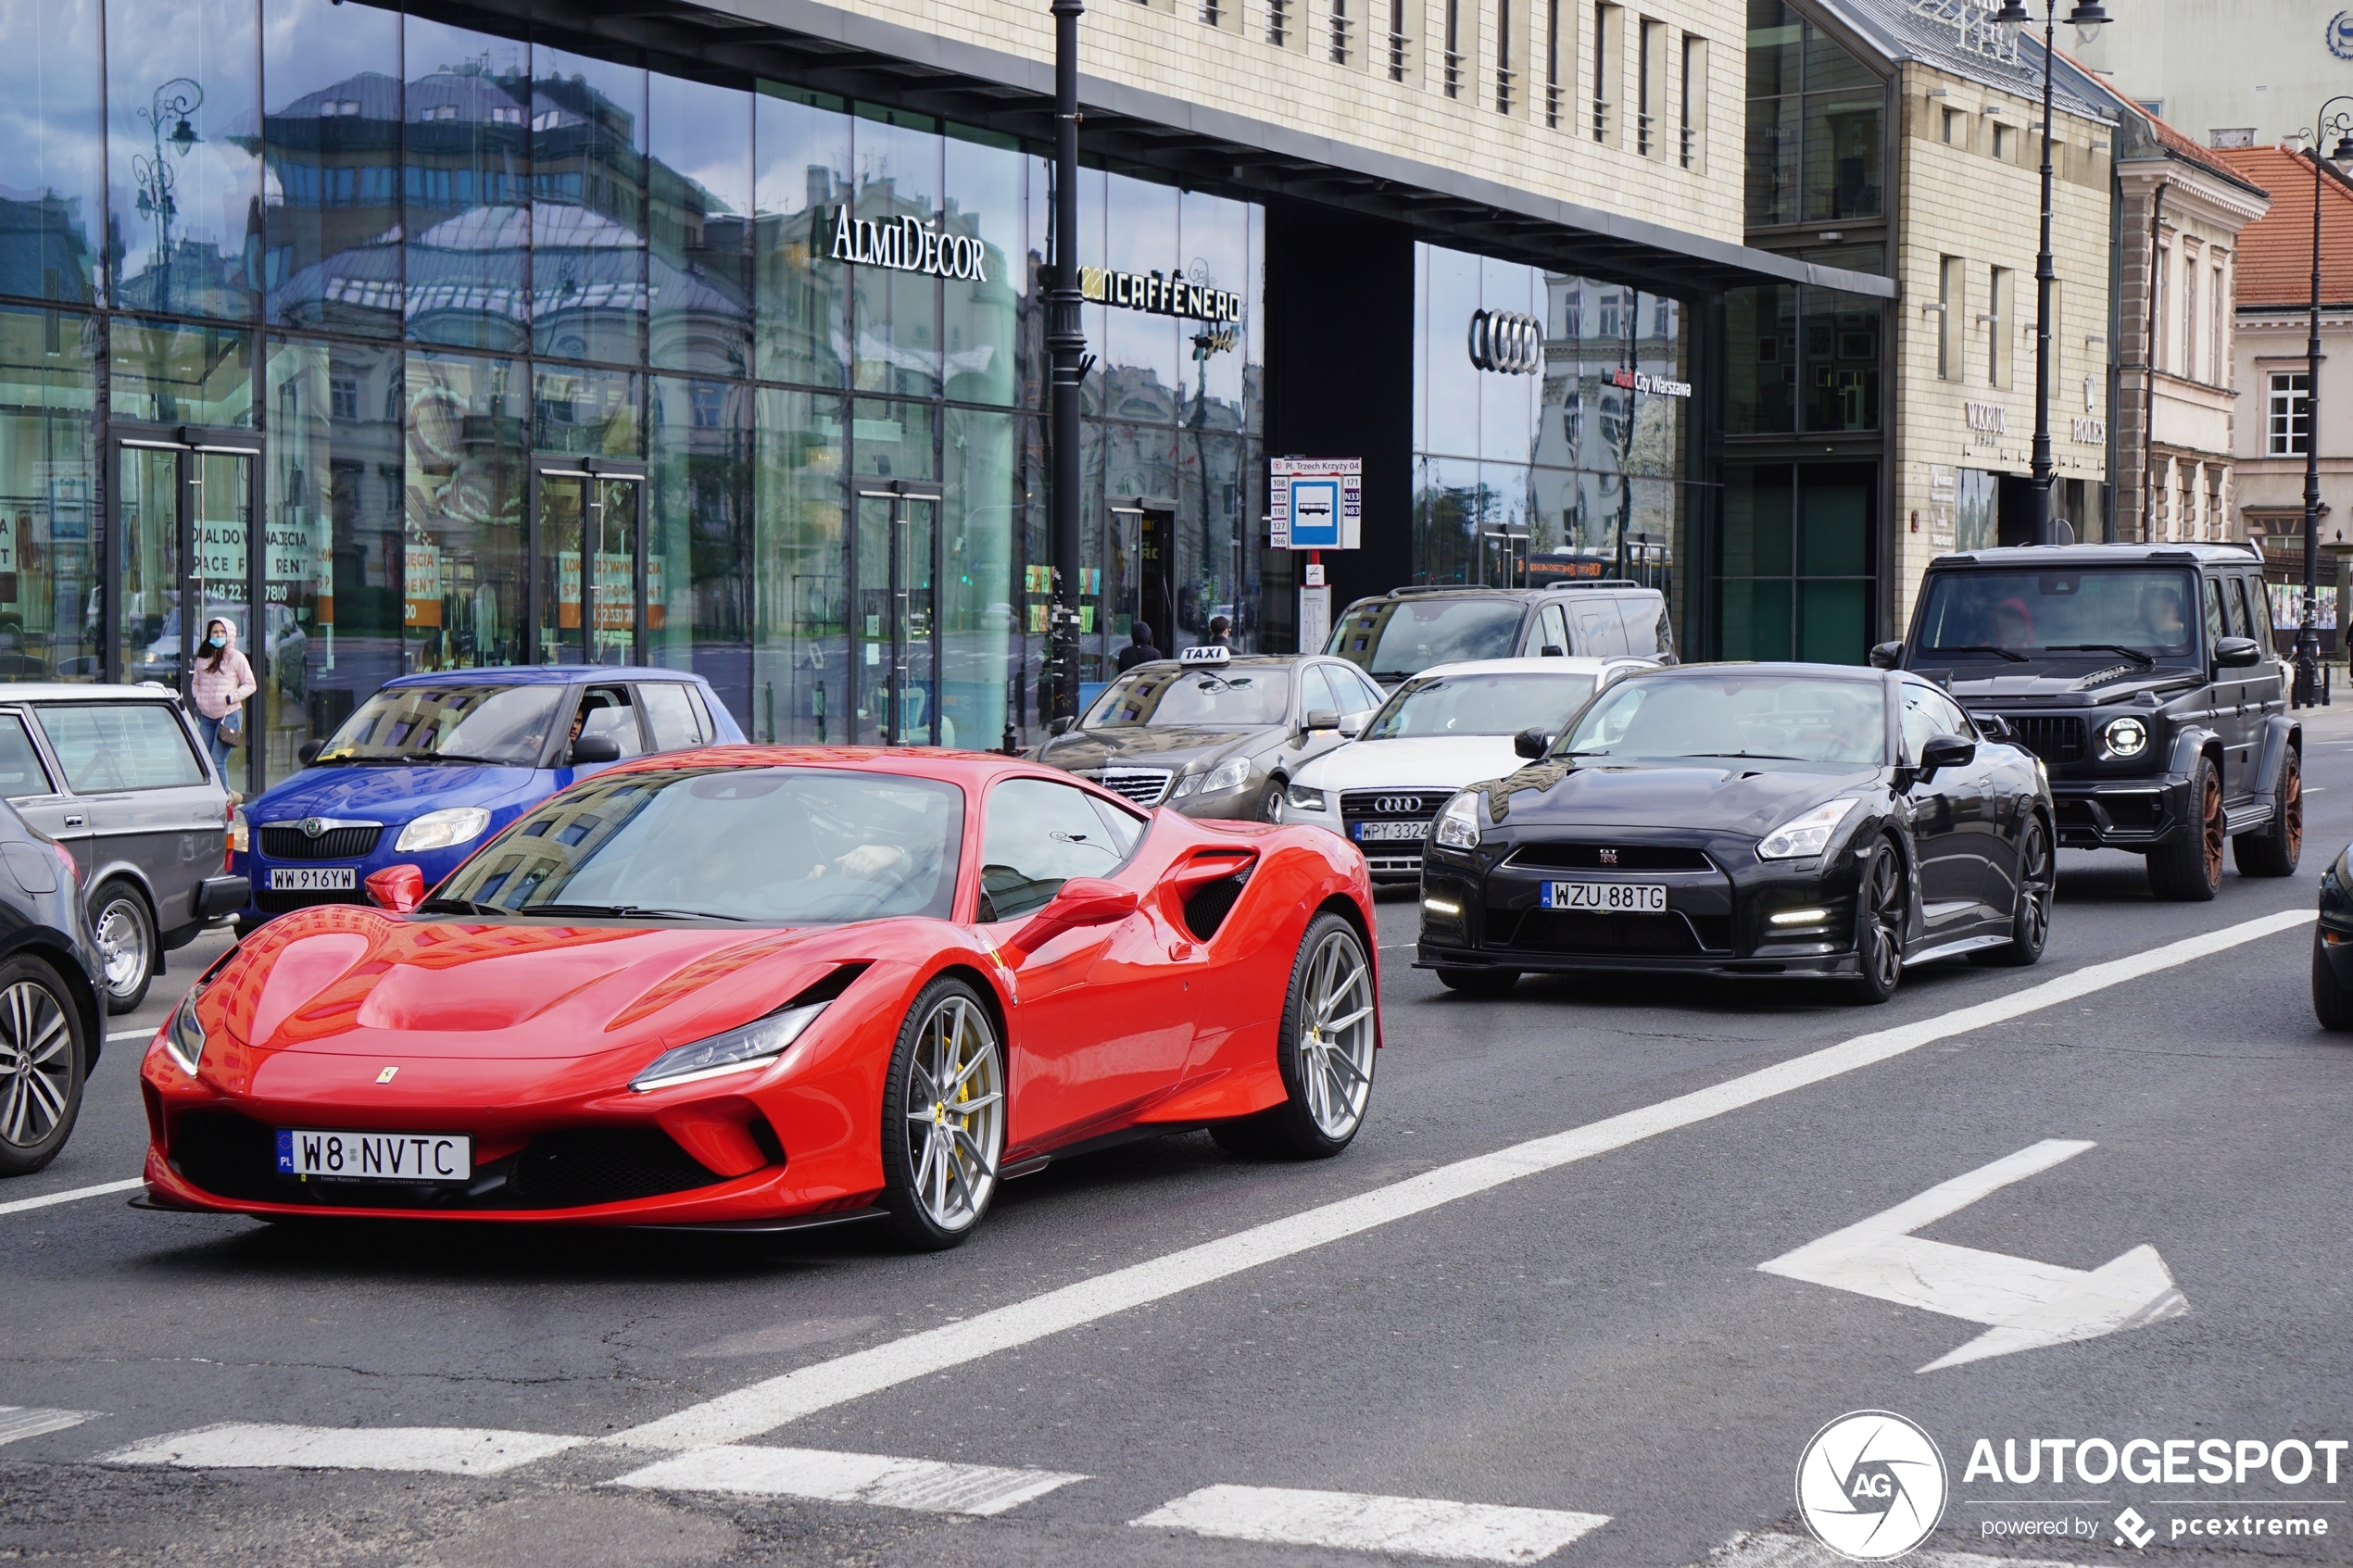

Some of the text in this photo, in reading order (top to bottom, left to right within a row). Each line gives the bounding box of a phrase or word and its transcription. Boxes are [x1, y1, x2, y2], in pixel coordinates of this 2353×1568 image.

[1189, 285, 1240, 322] NERO
[1612, 366, 1692, 397] Audi City Warszawa
[2072, 418, 2107, 445] ROLEX
[1322, 462, 1348, 471] Krzyży
[222, 529, 240, 545] DO
[193, 556, 229, 571] PACE
[276, 558, 308, 573] RENT
[205, 583, 225, 600] +48
[228, 584, 242, 600] 22
[606, 584, 627, 598] FOR
[1185, 647, 1223, 659] TAXI
[1363, 823, 1389, 839] WPY
[273, 872, 295, 888] WW
[301, 871, 351, 888] 916YW
[1555, 884, 1601, 907] WZU
[1609, 886, 1664, 909] 88TG
[281, 1135, 454, 1175] PL W8 NVTC
